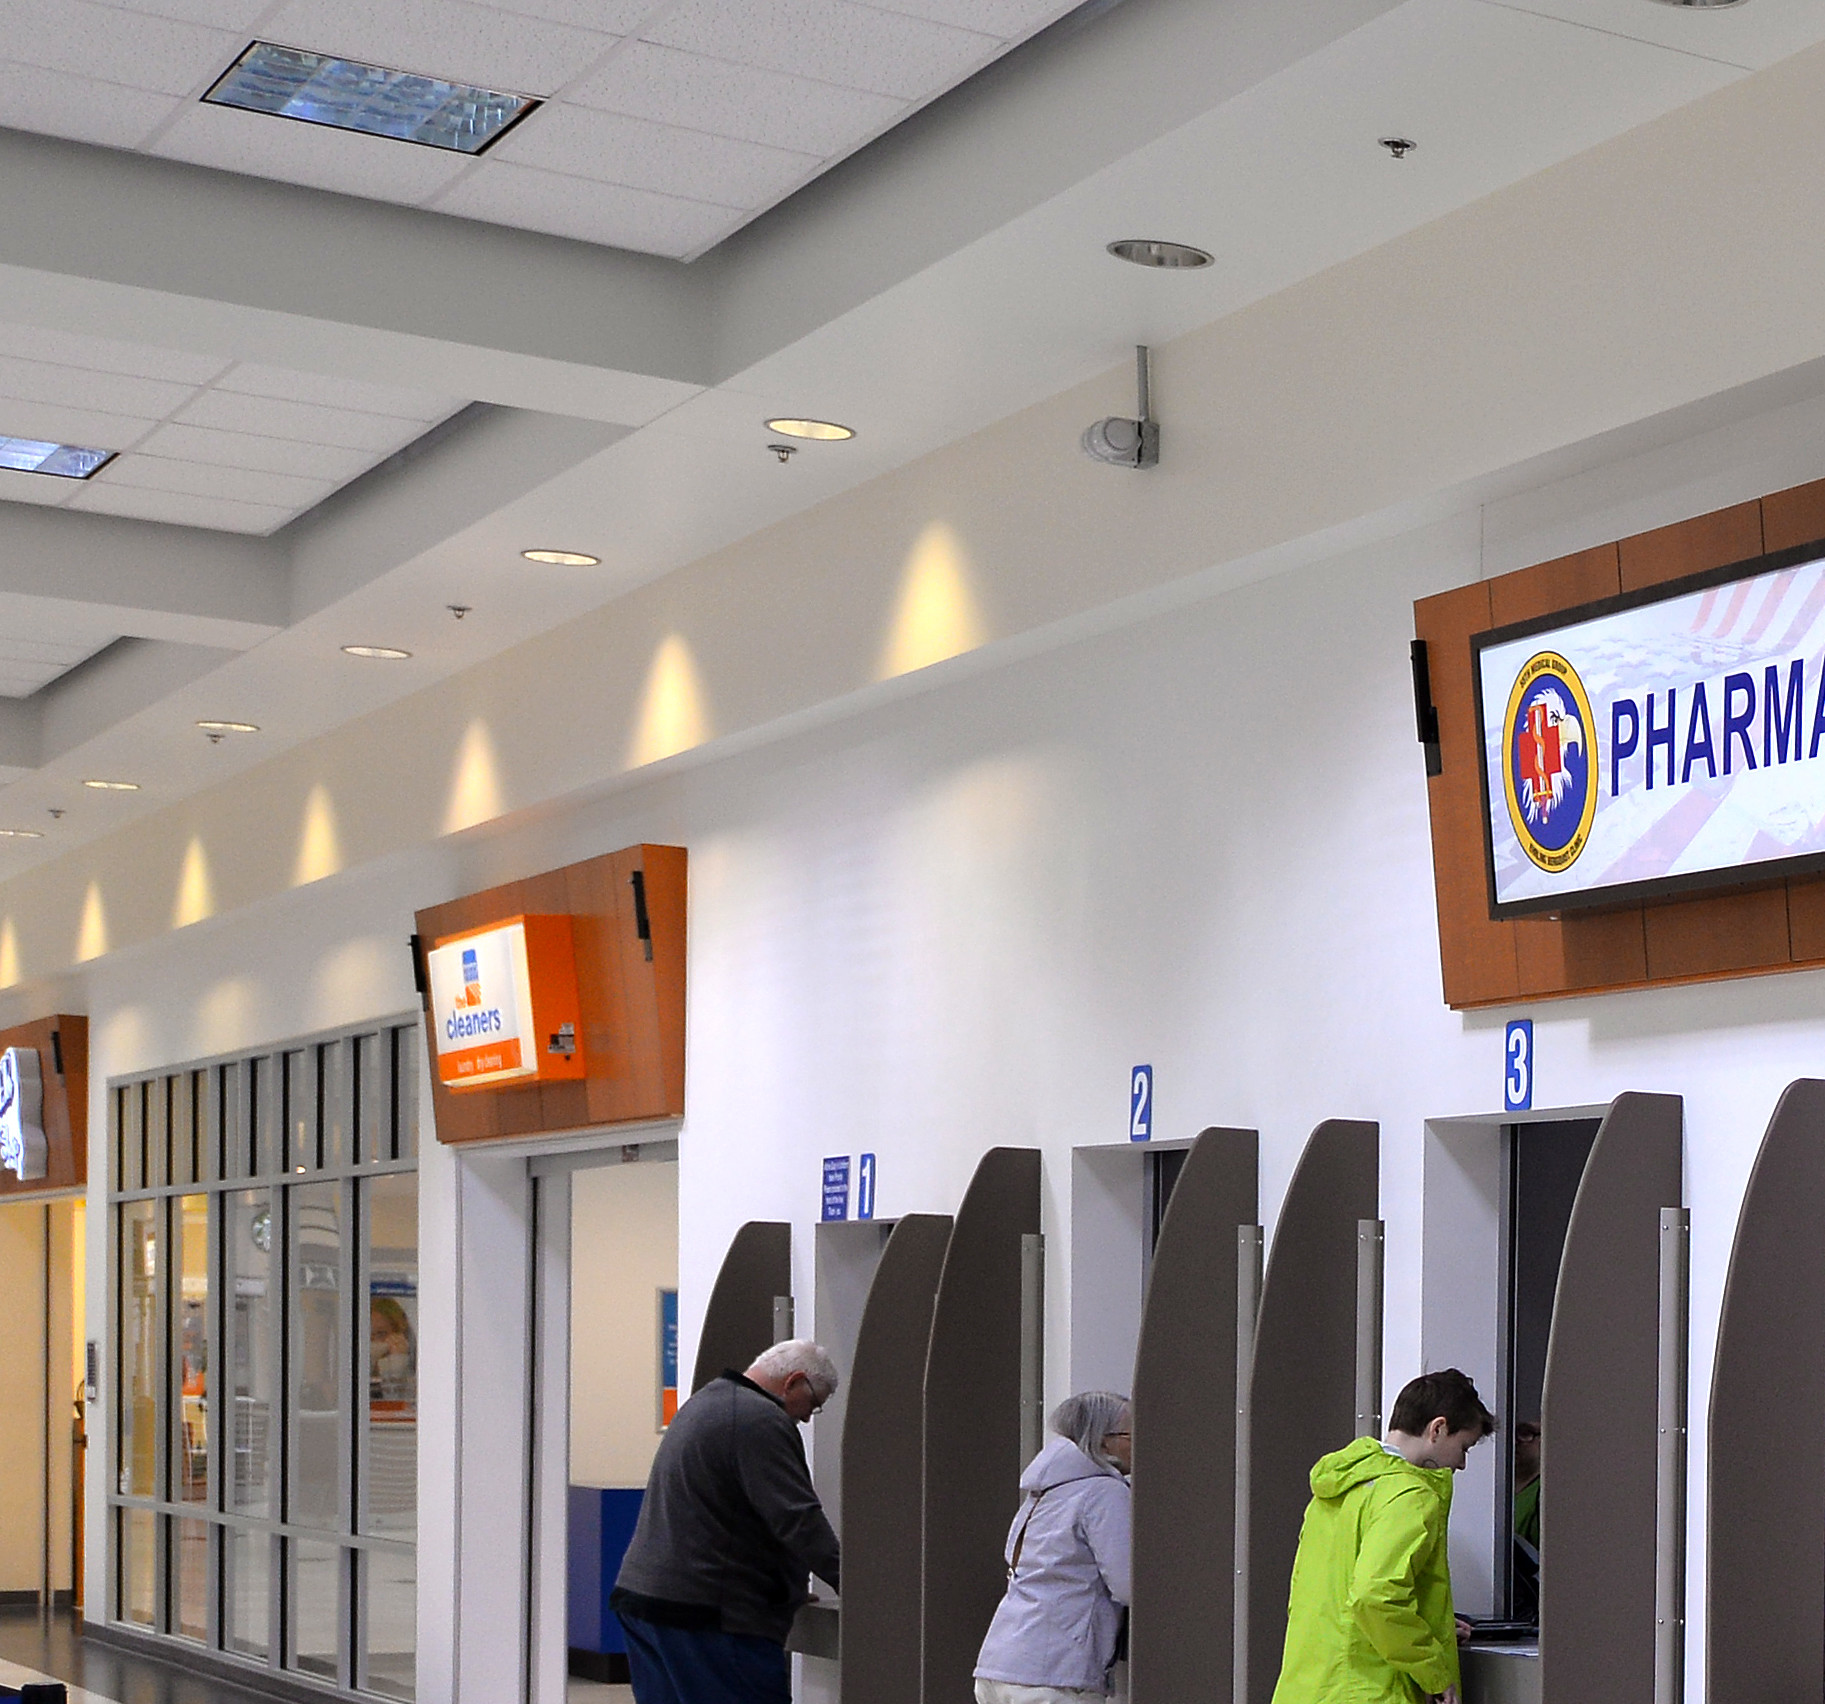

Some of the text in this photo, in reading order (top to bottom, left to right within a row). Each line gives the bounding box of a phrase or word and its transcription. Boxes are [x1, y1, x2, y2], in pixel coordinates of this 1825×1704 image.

[447, 1009, 501, 1040] cleaners
[1507, 1025, 1528, 1104] 3
[1132, 1072, 1151, 1134] 2
[861, 1158, 871, 1214] 1
